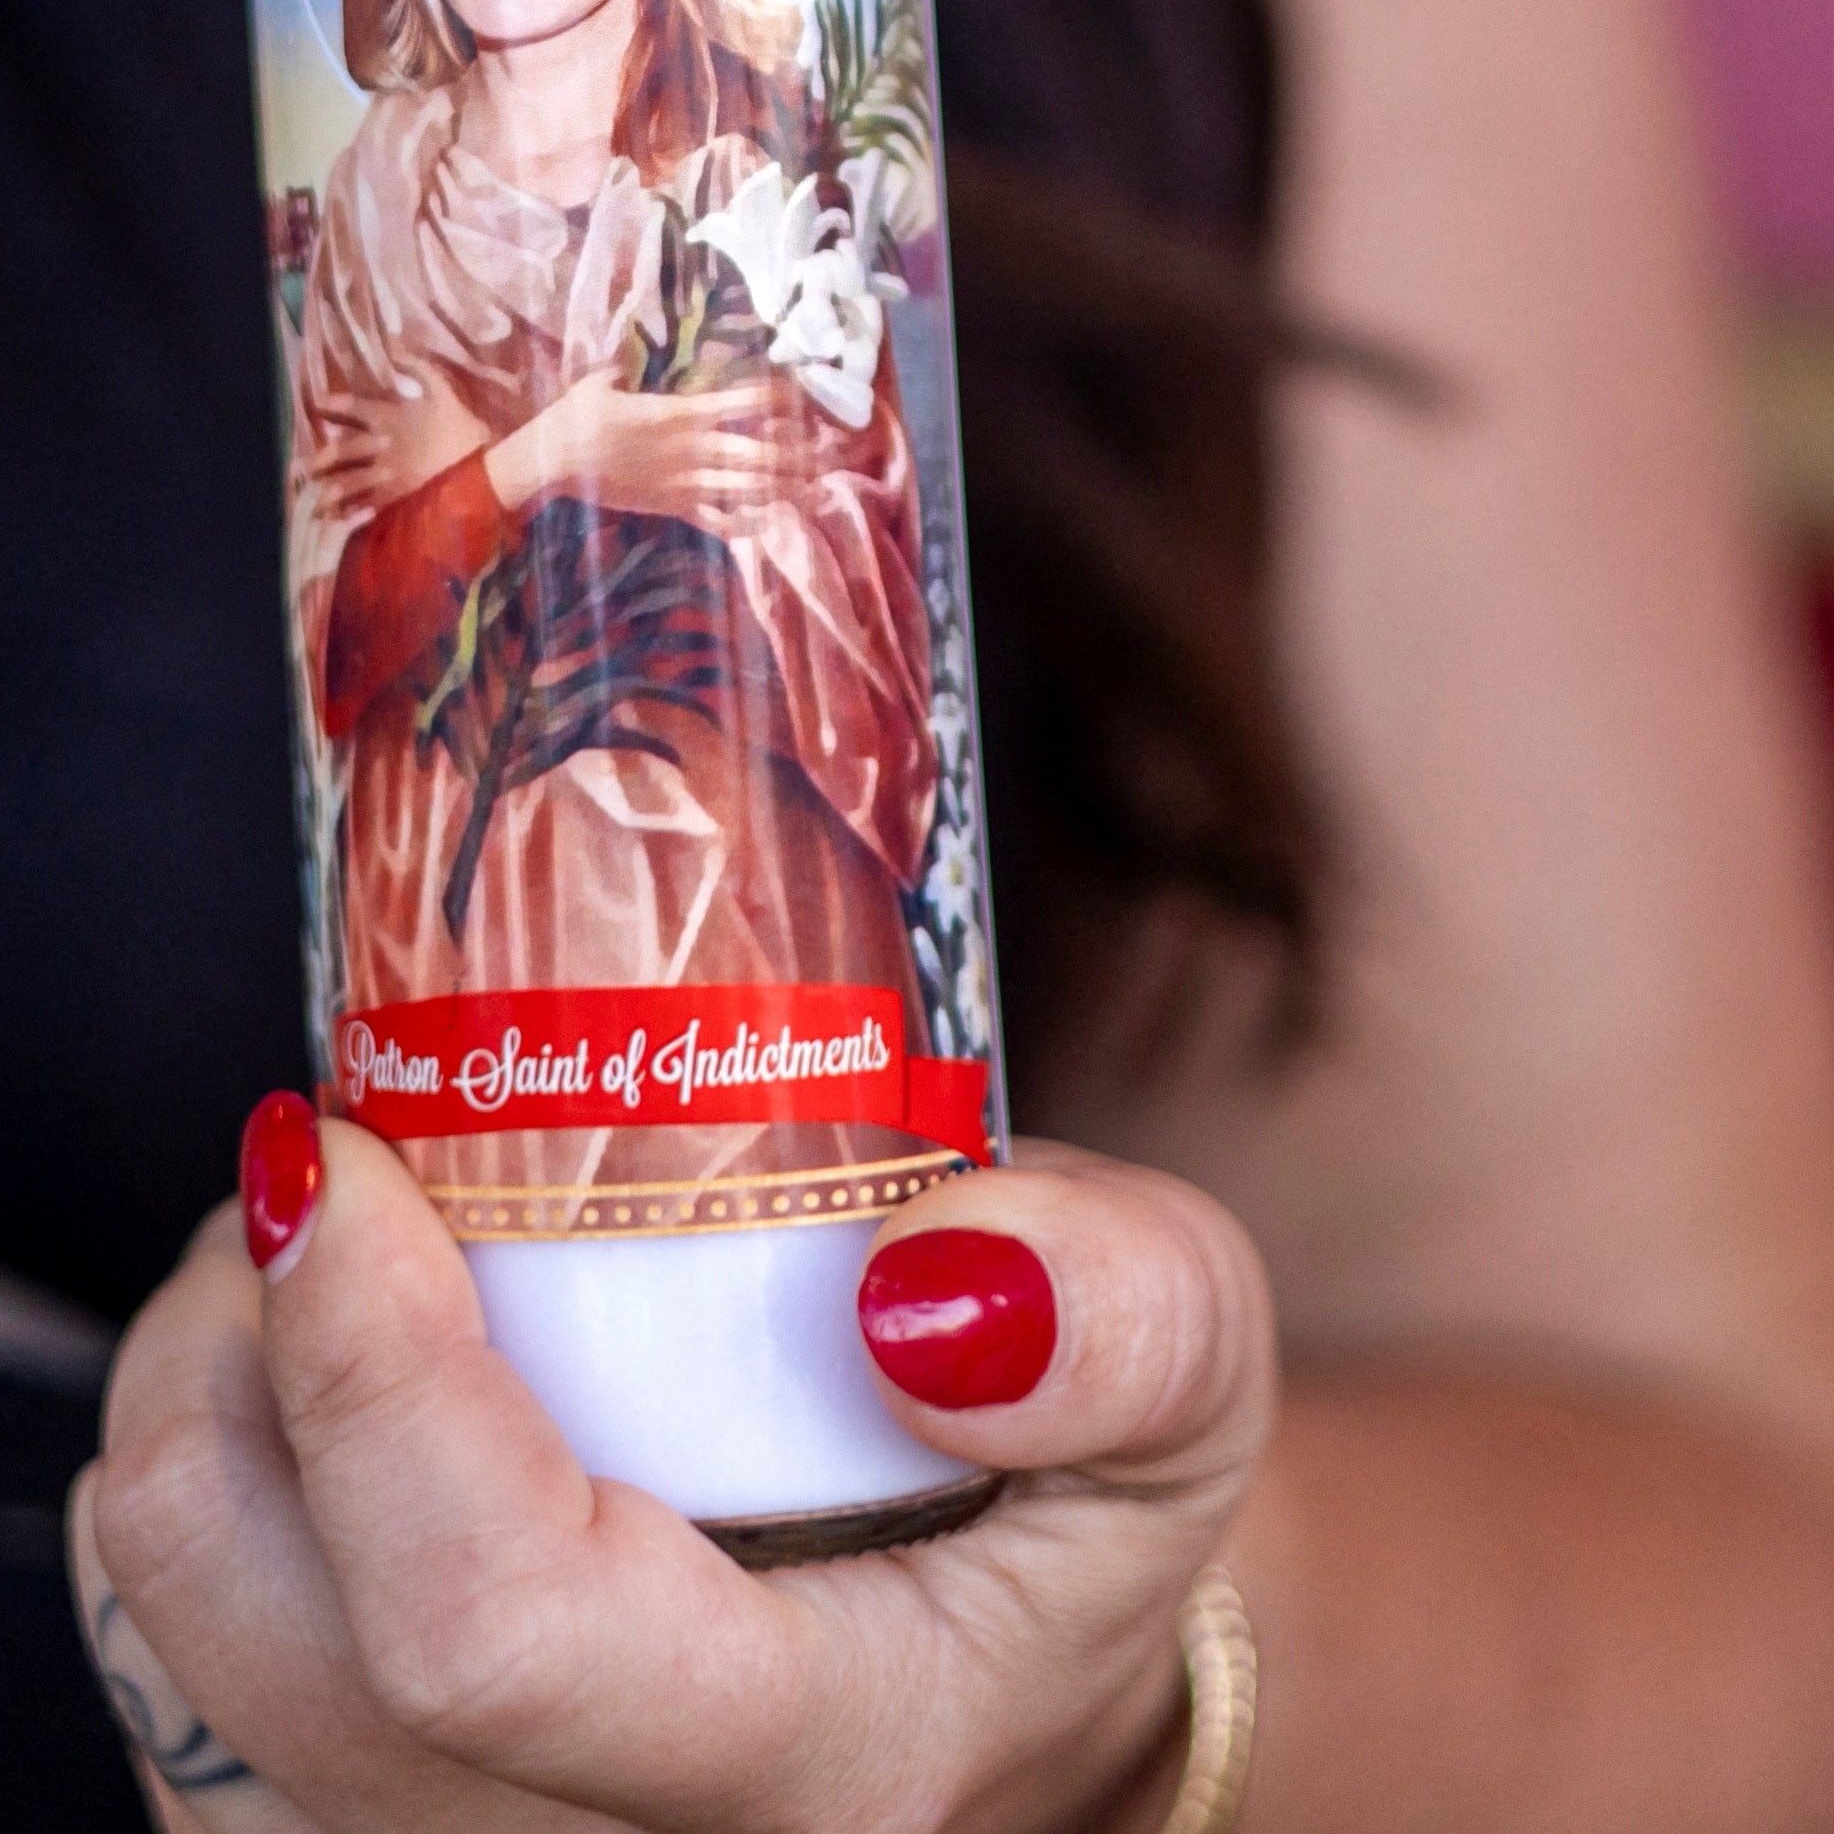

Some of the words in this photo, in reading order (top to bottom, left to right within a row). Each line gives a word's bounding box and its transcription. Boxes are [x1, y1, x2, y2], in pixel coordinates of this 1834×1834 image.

[343, 1020, 443, 1106] Patron
[449, 1026, 593, 1113] Saint
[601, 1028, 647, 1109] of
[651, 1016, 890, 1106] Indictments
